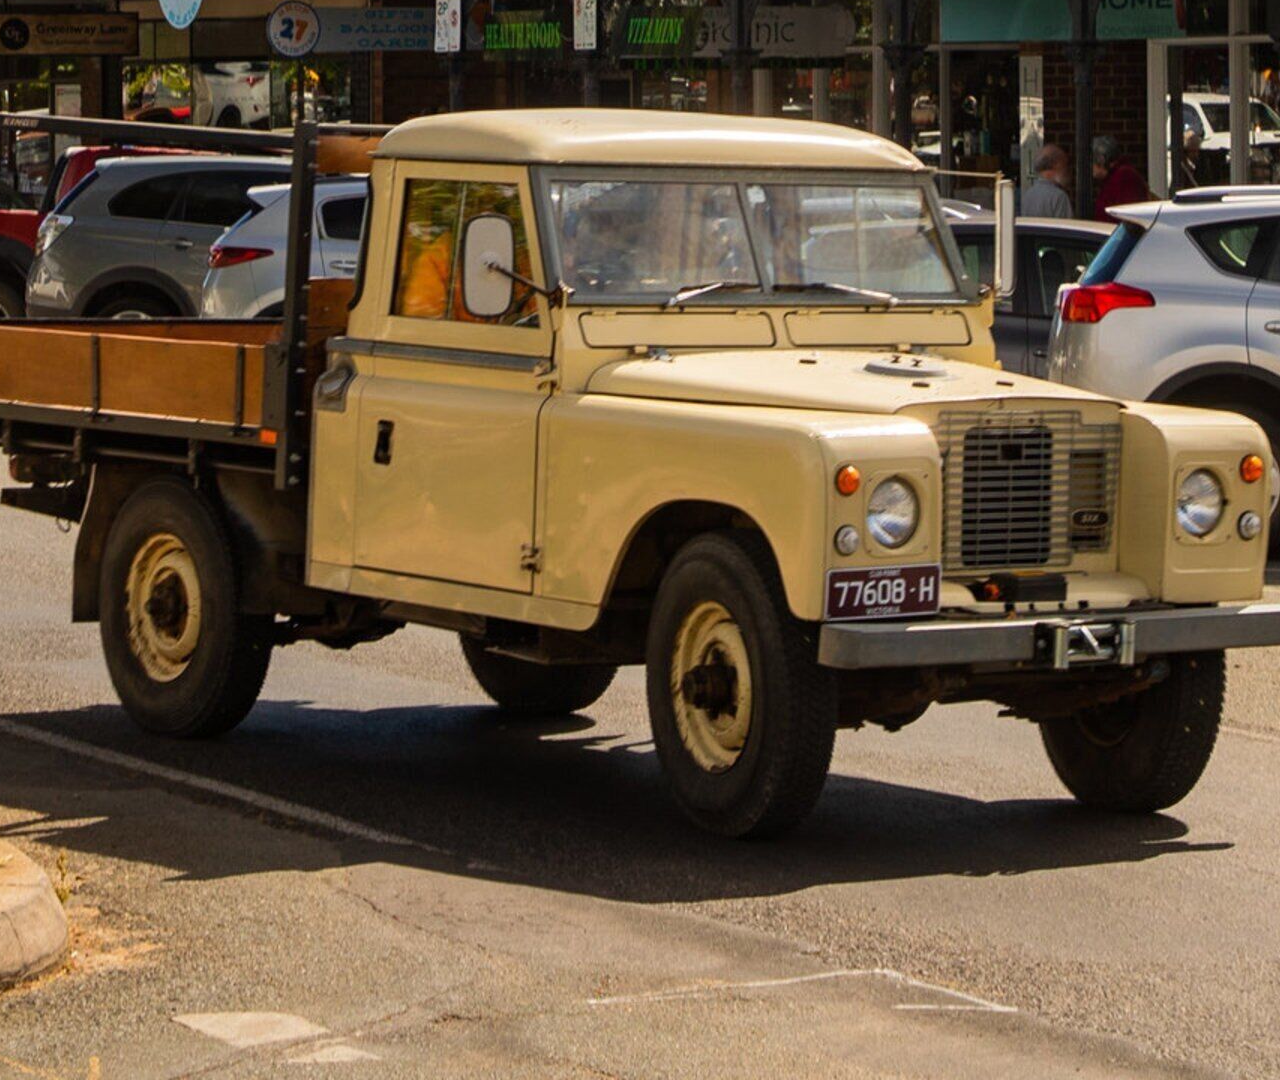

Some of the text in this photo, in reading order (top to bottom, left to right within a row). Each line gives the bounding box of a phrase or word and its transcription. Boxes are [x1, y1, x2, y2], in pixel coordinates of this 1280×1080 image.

[36, 22, 97, 37] Greenway
[279, 17, 309, 42] 27
[339, 23, 435, 34] BALLOON
[628, 17, 684, 45] VITAMINS
